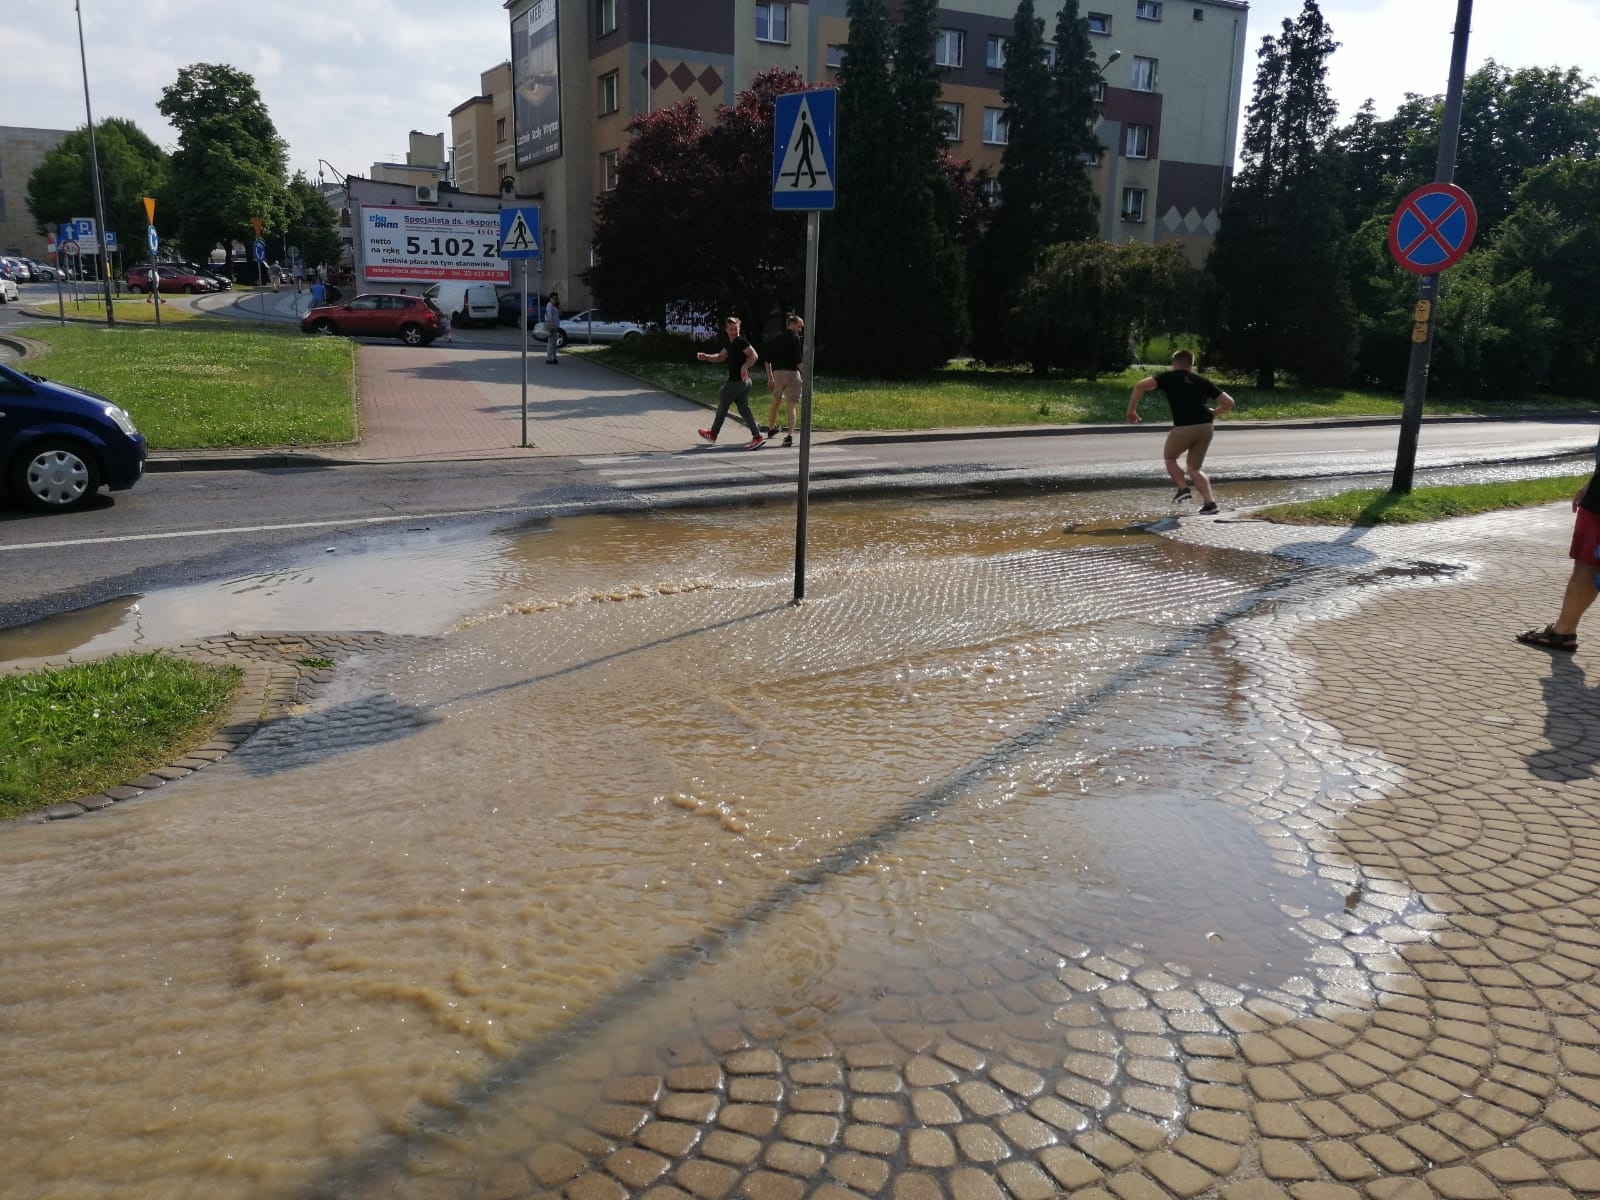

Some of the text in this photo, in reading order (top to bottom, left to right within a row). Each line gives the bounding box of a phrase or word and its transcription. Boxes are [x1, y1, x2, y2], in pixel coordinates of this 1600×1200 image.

[404, 215, 450, 225] Specjalista
[382, 247, 400, 255] rękę
[406, 236, 501, 258] 5.102 zł
[381, 256, 408, 264] średnia
[409, 258, 428, 266] płaca
[455, 260, 495, 268] stanowisku
